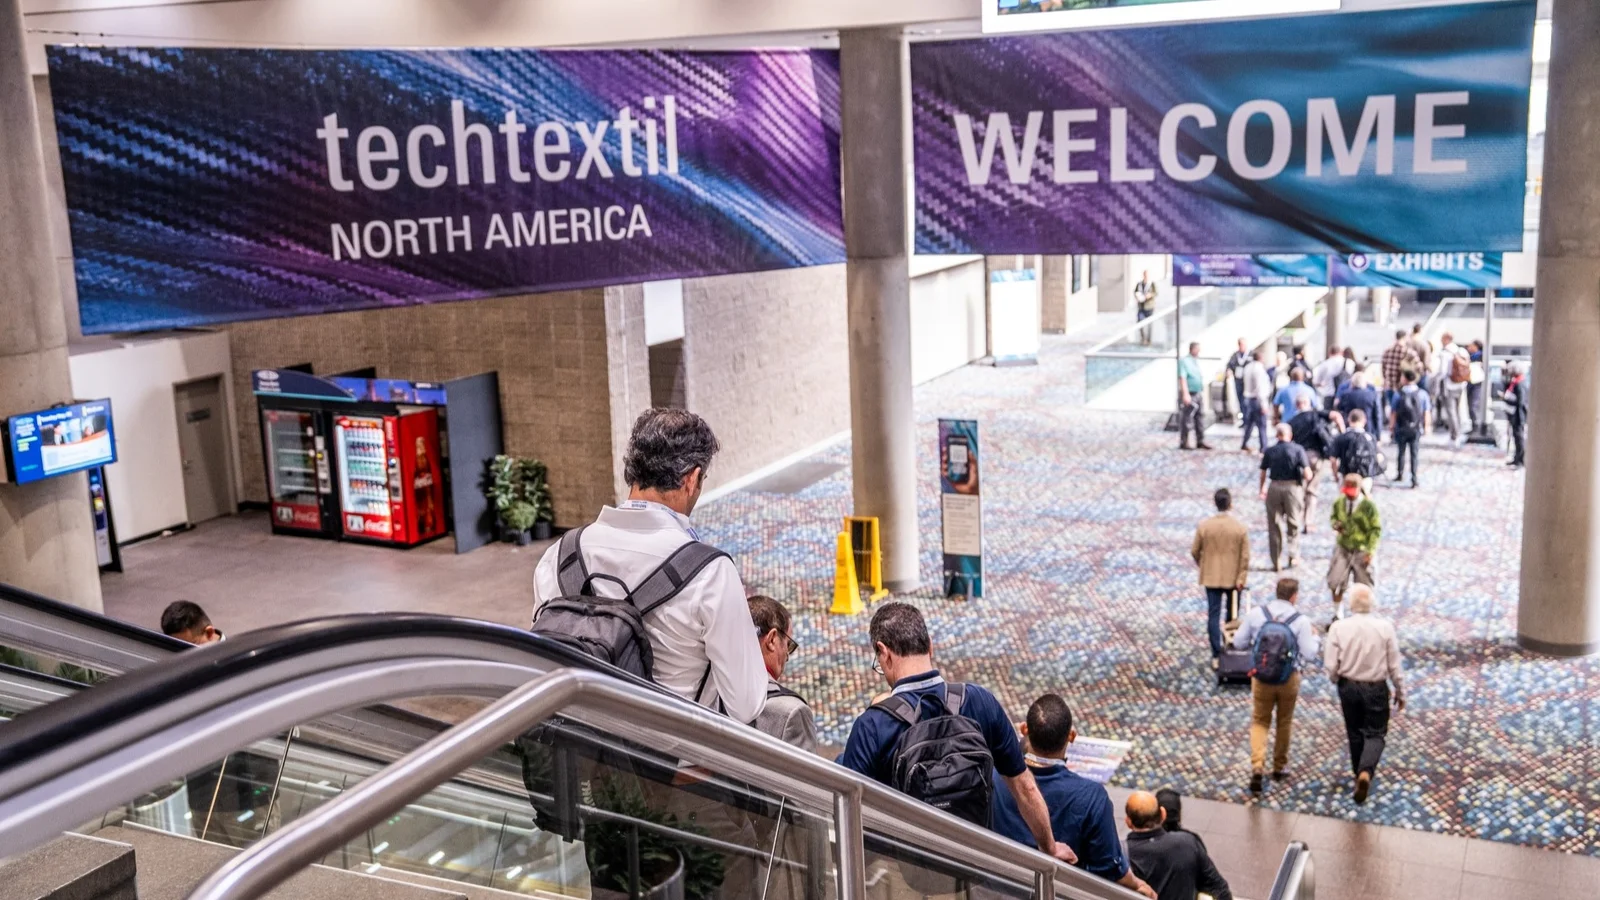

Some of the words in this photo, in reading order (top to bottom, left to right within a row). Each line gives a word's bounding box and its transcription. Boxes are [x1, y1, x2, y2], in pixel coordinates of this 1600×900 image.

[316, 95, 679, 192] techtextil
[952, 90, 1469, 186] WELCOME
[330, 215, 472, 261] NORTH
[484, 204, 652, 250] AMERICA
[1374, 252, 1484, 271] EXHIBITS
